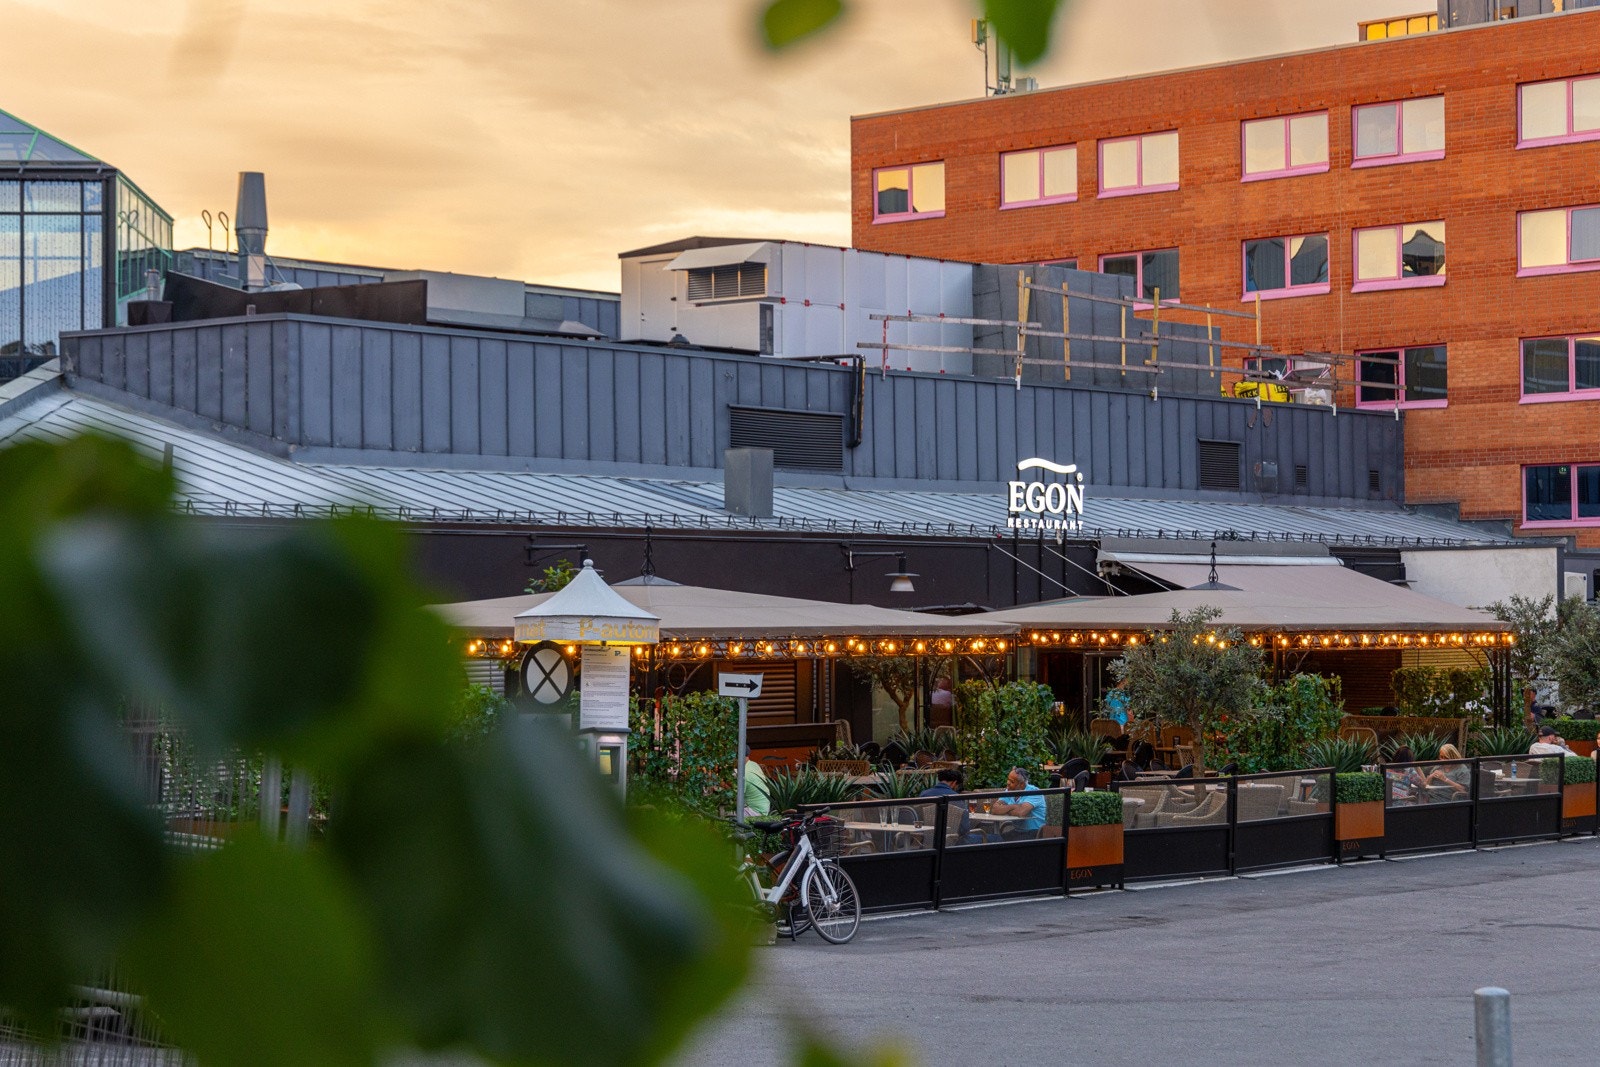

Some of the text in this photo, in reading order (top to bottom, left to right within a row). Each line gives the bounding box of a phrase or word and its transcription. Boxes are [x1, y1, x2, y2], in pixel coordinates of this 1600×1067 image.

[1008, 480, 1085, 514] EGON
[1007, 517, 1084, 531] RESTAURANT
[1070, 868, 1093, 880] EGON
